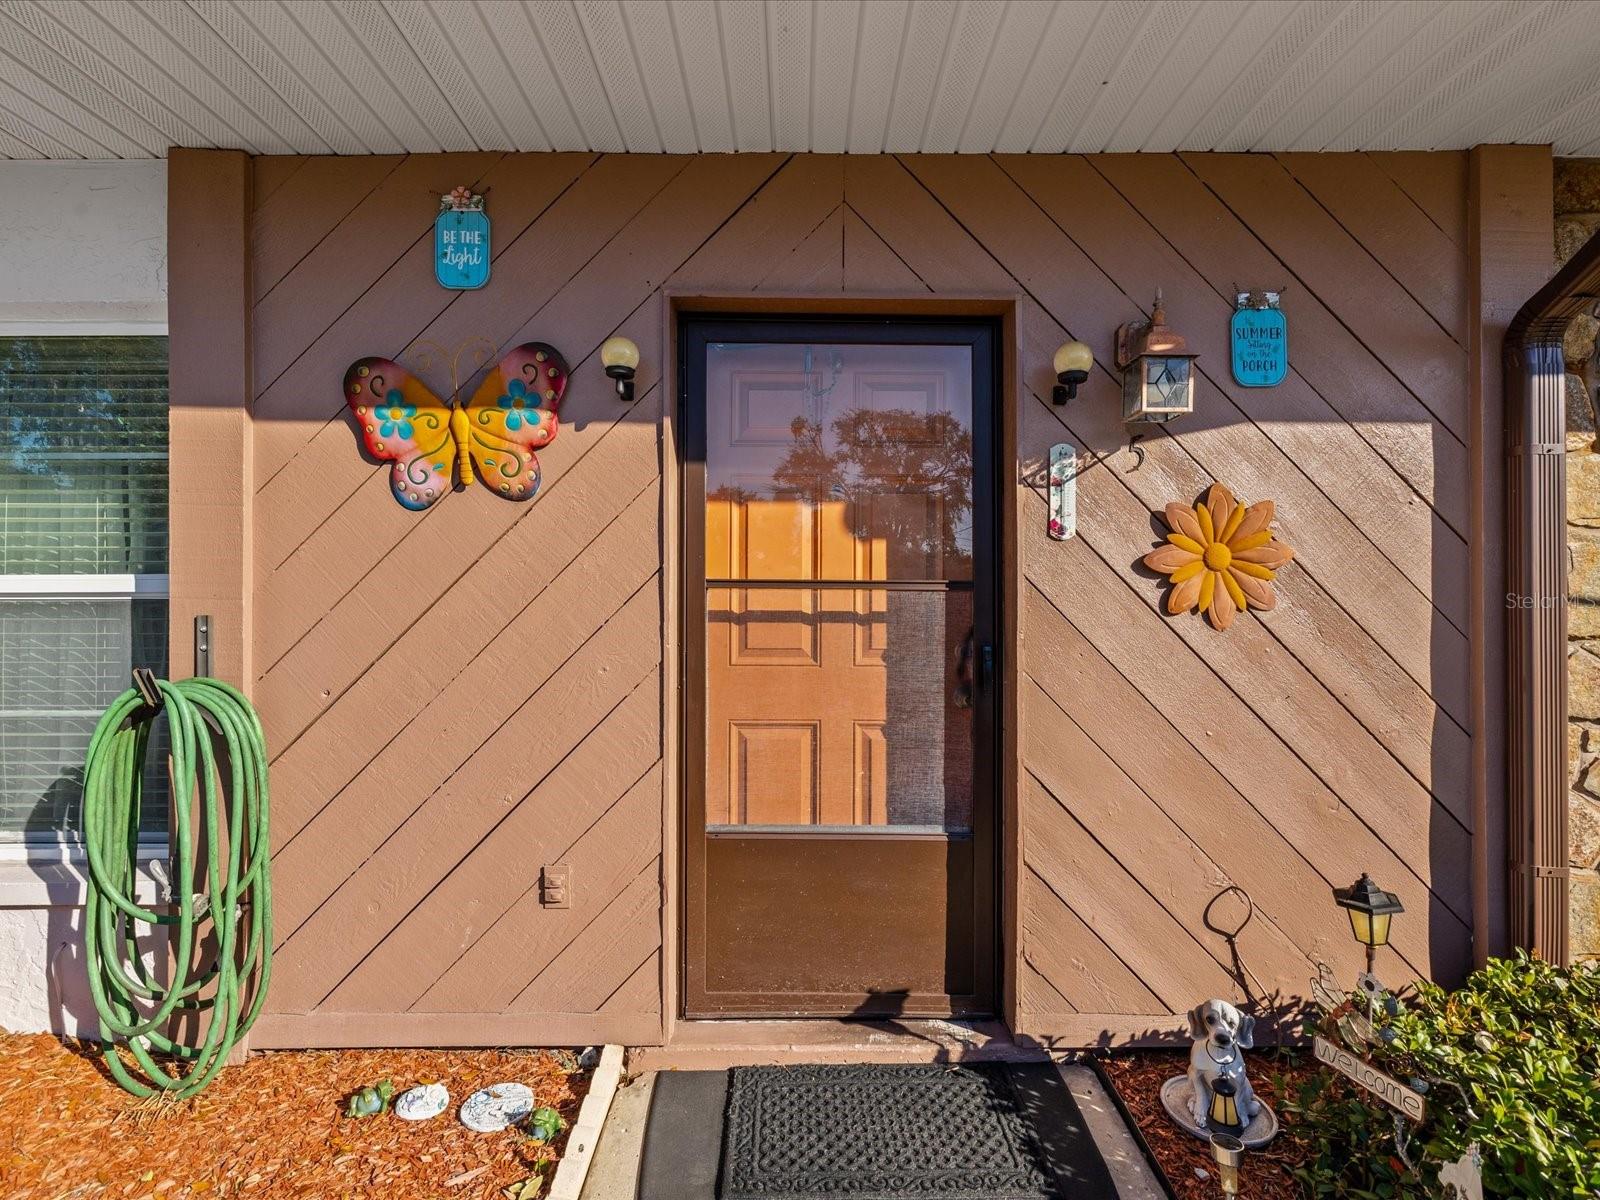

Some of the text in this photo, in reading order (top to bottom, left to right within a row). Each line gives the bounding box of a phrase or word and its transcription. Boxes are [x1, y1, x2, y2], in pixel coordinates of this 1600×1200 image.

[443, 230, 481, 244] BE THE
[442, 245, 482, 270] Light
[1235, 327, 1283, 340] SUMMER
[1242, 360, 1277, 373] PORCH
